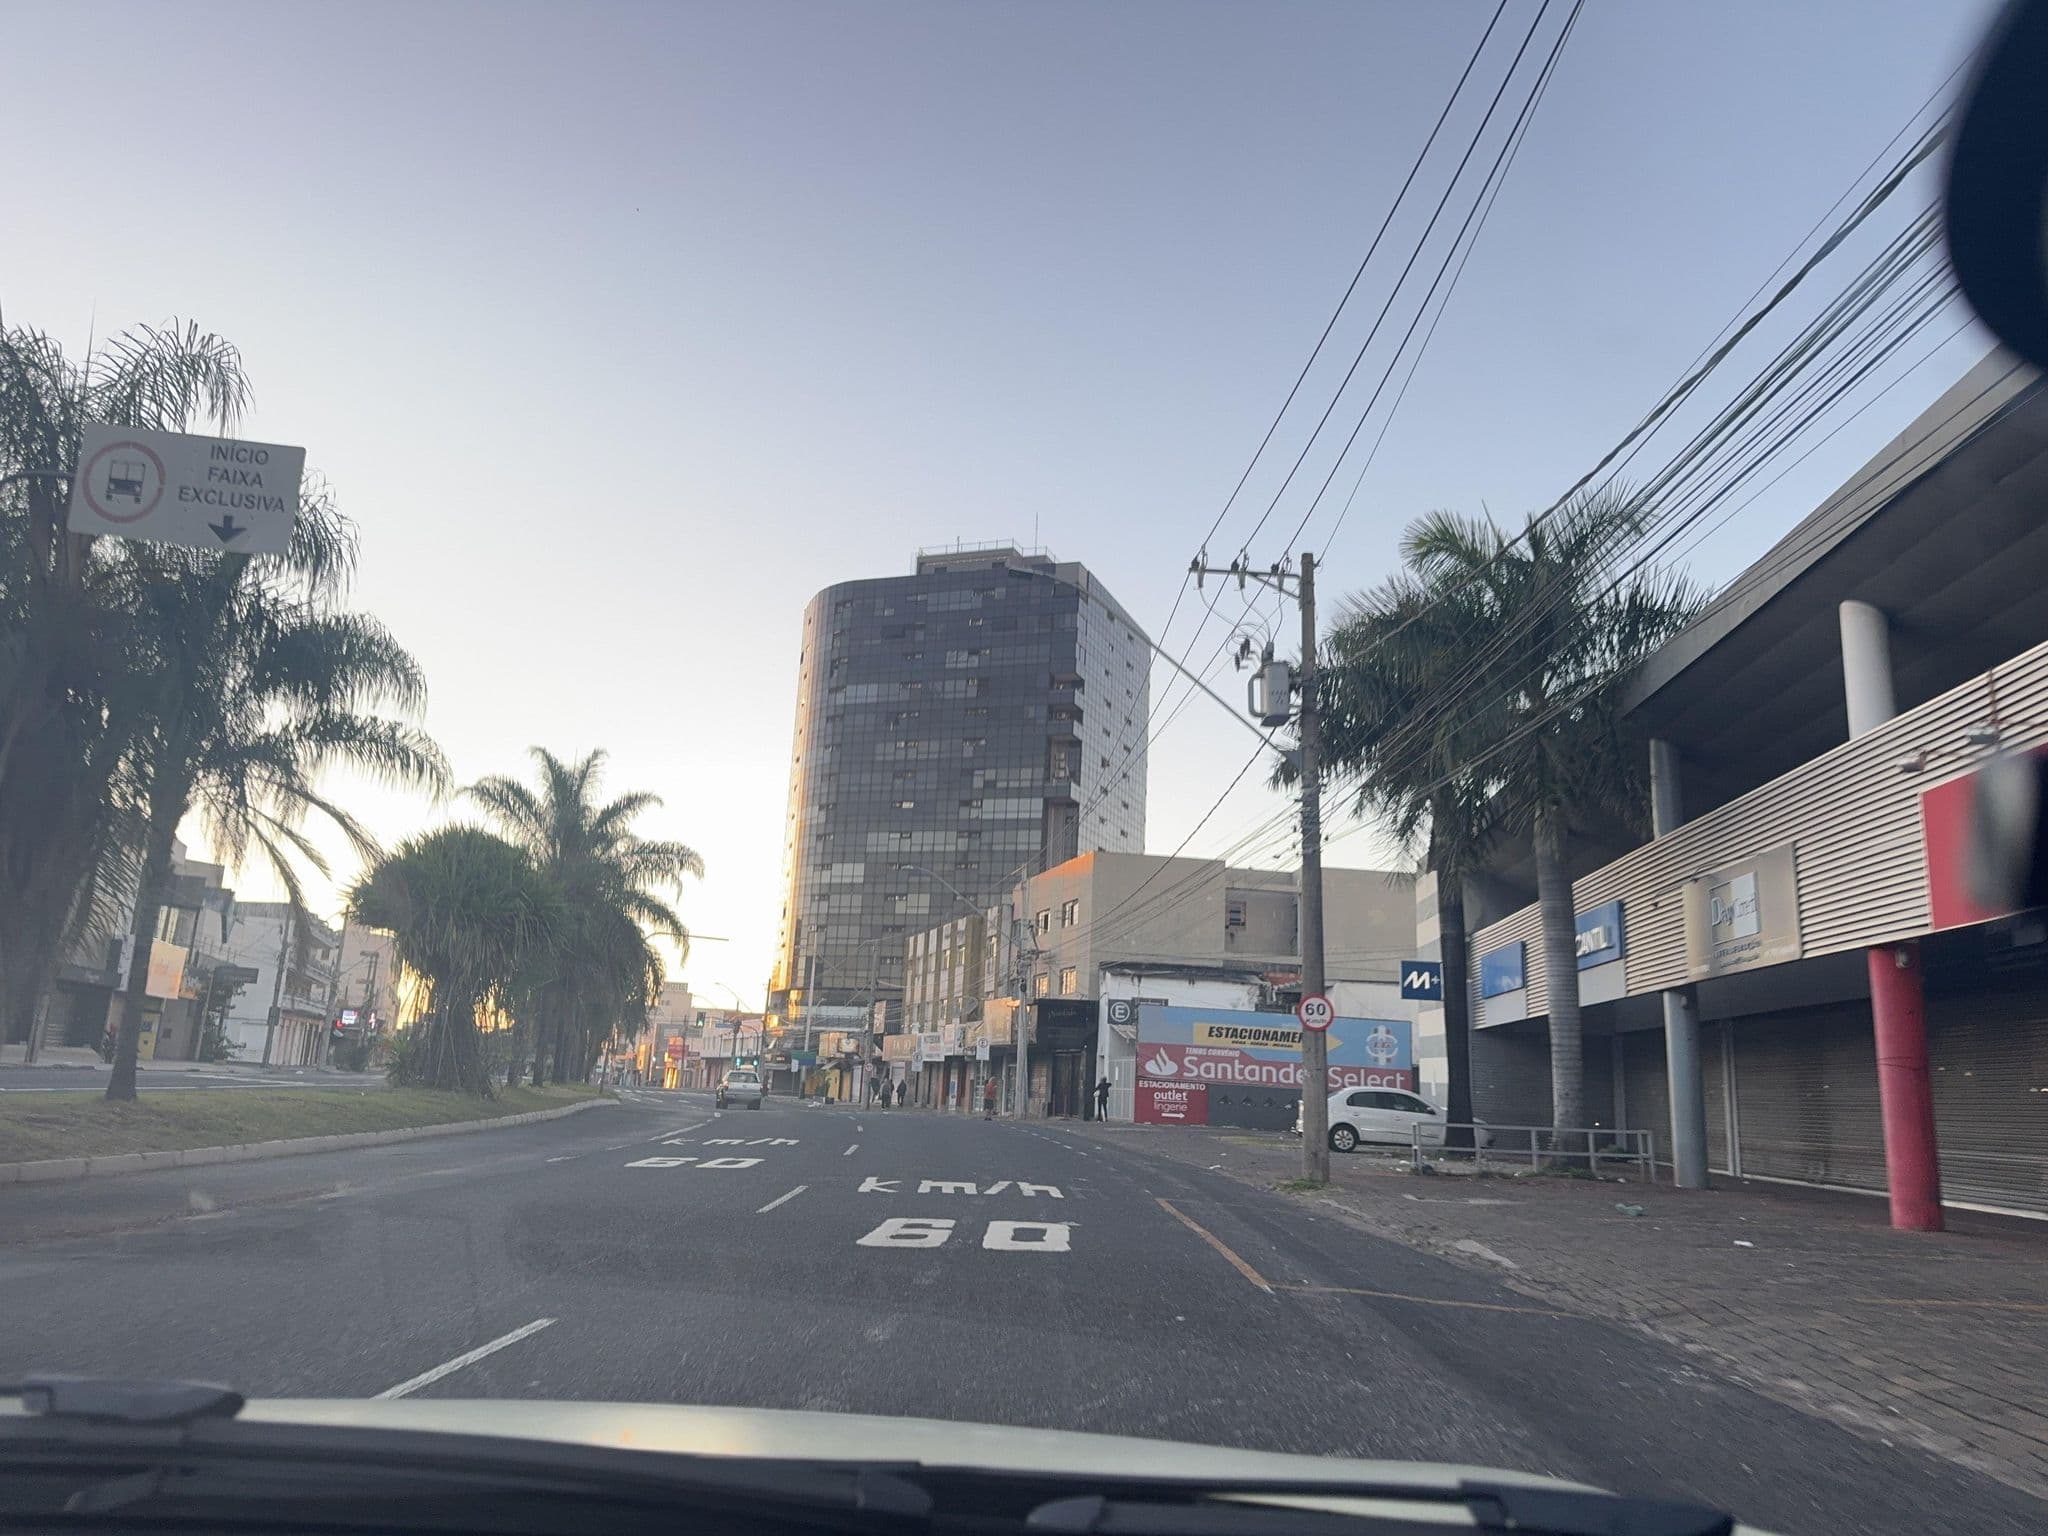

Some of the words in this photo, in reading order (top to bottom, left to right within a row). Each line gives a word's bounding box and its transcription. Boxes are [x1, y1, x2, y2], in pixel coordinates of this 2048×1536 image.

[210, 442, 270, 465] INÍCIO
[207, 466, 263, 489] FAIXA
[178, 485, 285, 513] EXCLUSIVA
[1115, 1005, 1126, 1018] E
[1305, 1003, 1326, 1016] 60
[1183, 1056, 1305, 1085] Santande
[1327, 1066, 1405, 1089] Select
[1138, 1079, 1207, 1092] ESTACIONAMENTO
[1153, 1090, 1188, 1101] outlet
[1153, 1101, 1188, 1112] lingerie
[855, 1217, 1073, 1252] 60
